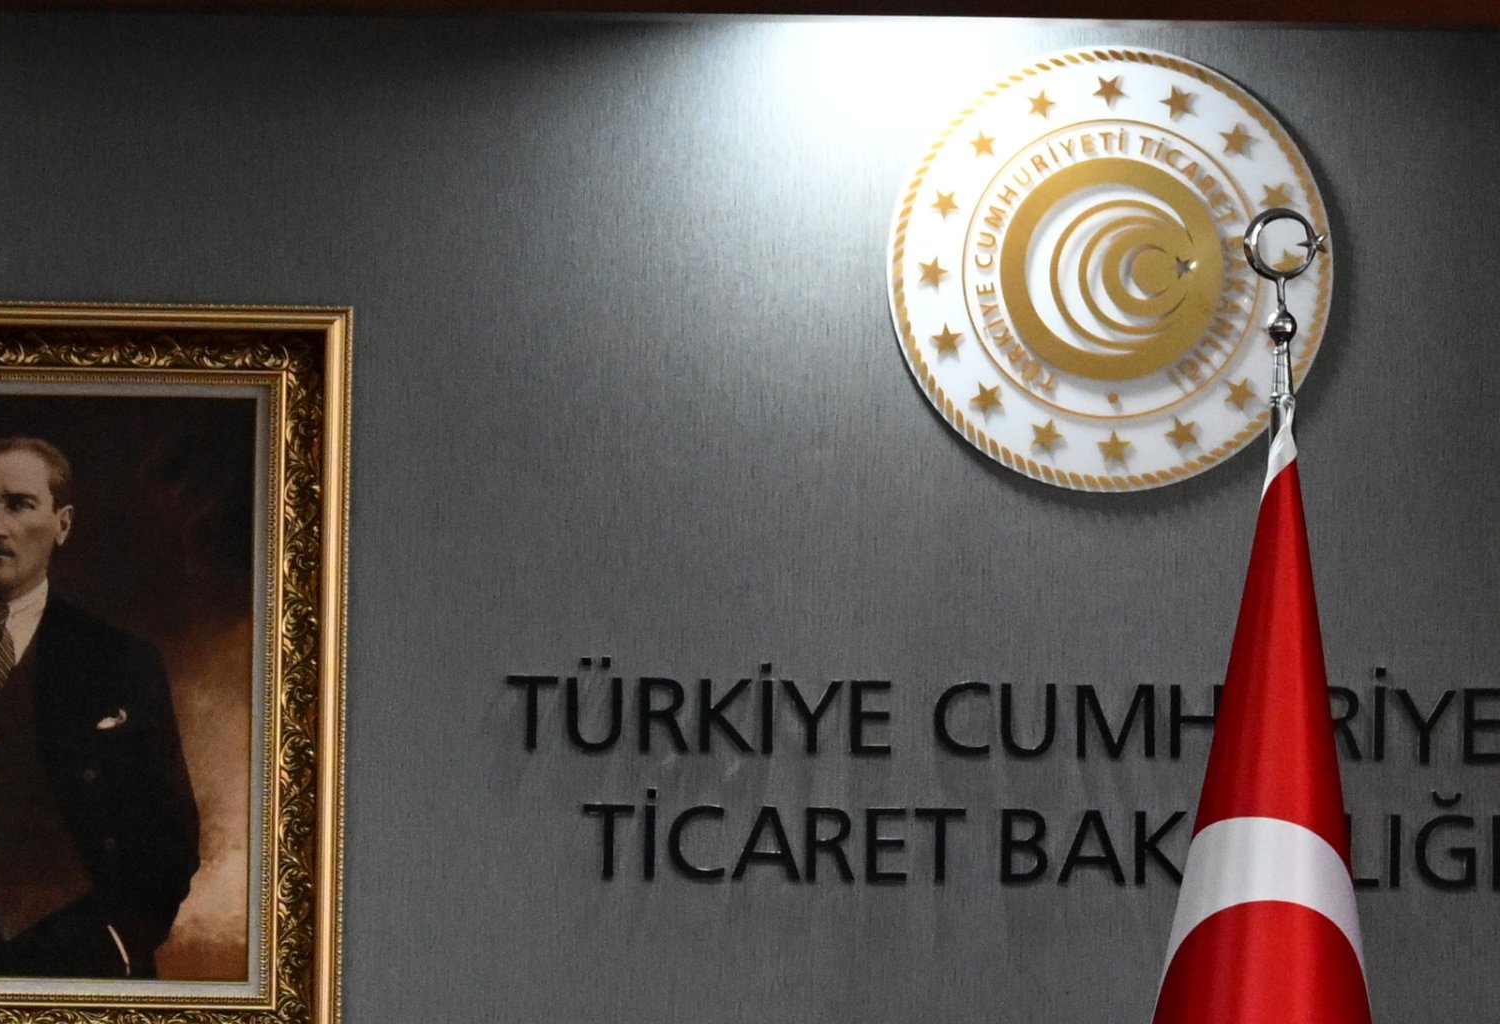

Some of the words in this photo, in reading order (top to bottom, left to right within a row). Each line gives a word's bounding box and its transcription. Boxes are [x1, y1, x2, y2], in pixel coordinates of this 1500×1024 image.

[975, 128, 1125, 269] CUMHURİYETİ
[1139, 136, 1238, 222] TİCARET
[506, 657, 892, 755] TÜRKİYE
[933, 666, 1500, 764] CUMHRİYE
[583, 788, 967, 883] TİCARET
[1000, 789, 1500, 893] BAKLIĞI
